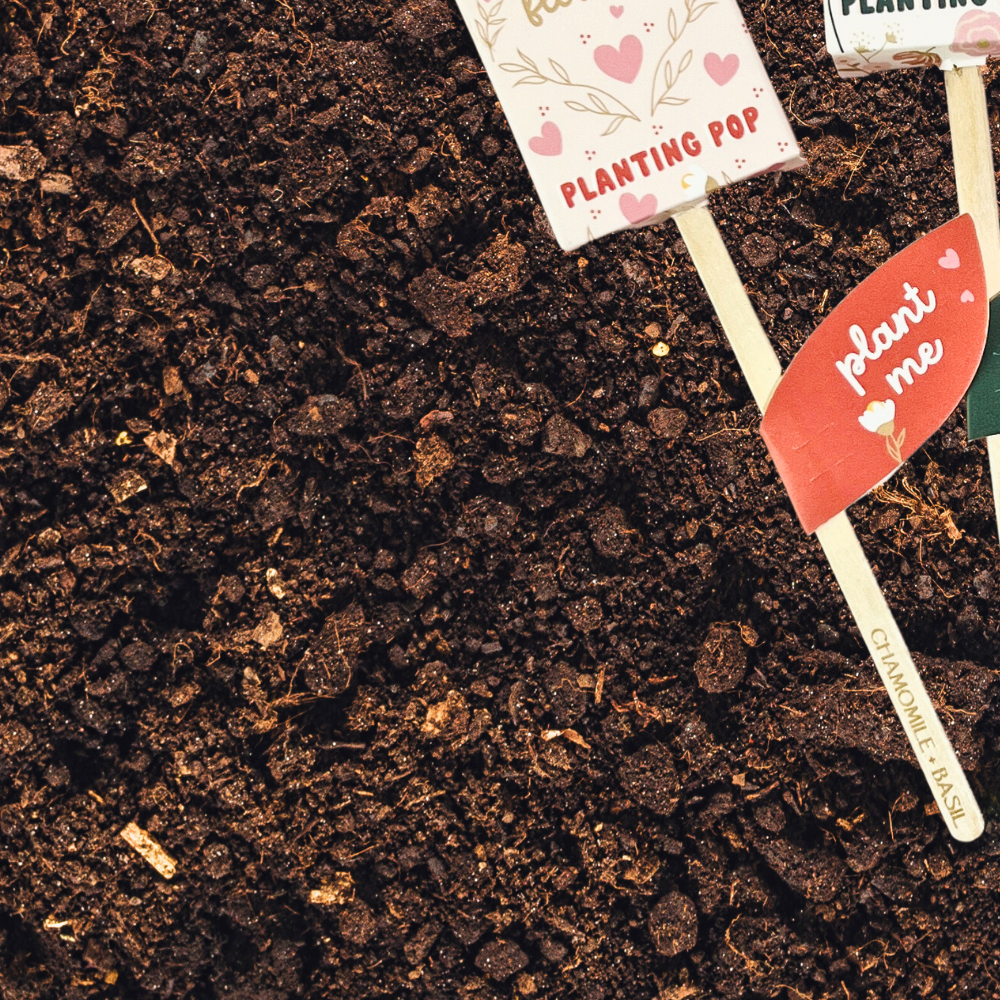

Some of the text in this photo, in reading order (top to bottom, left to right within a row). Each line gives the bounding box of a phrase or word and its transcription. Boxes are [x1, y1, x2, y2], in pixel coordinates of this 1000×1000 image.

[561, 106, 760, 208] PLANTING POP
[835, 280, 936, 397] plant
[886, 337, 944, 396] me
[870, 627, 936, 754] CHAMOMILE
[931, 767, 968, 830] BASIL
